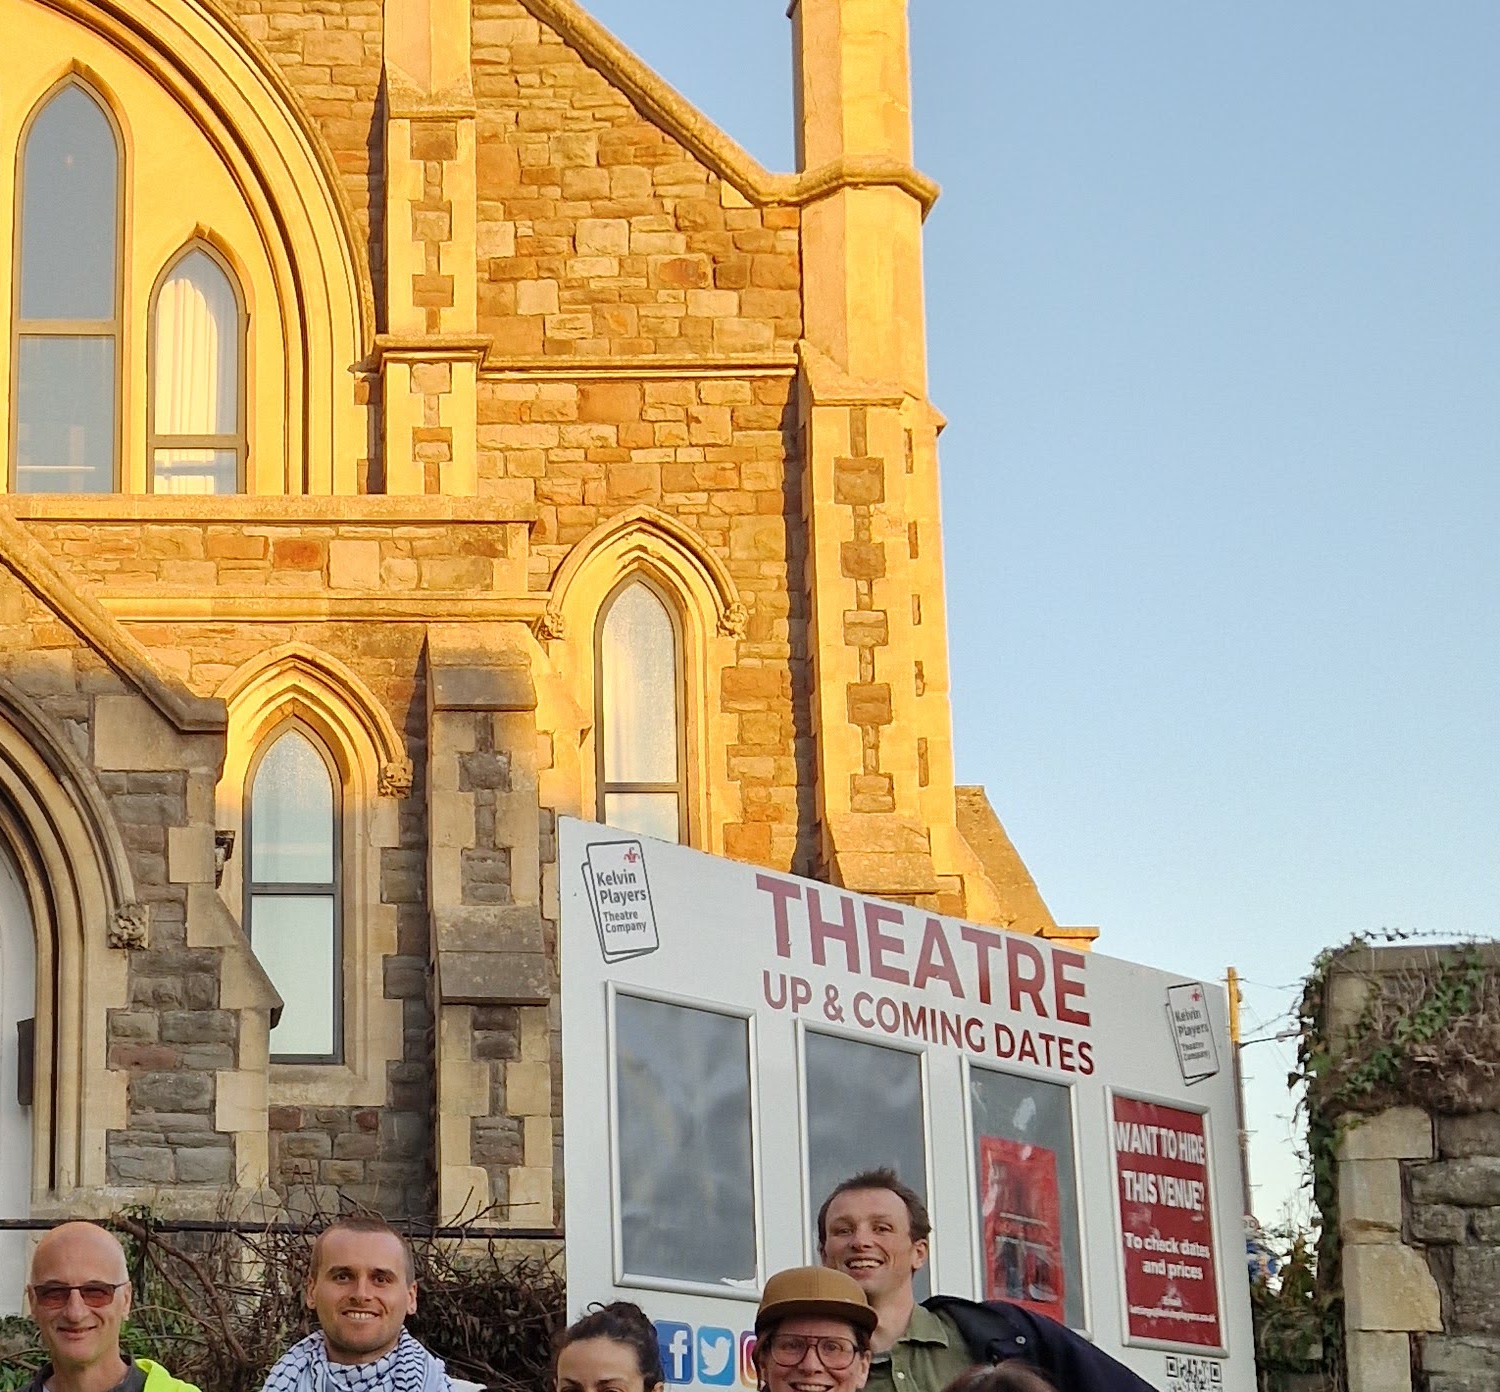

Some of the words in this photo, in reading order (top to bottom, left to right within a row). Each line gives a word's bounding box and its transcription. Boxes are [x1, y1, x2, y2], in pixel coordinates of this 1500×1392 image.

[596, 868, 637, 887] Kelvin
[600, 888, 647, 907] Players
[603, 910, 638, 922] Theatre
[605, 921, 647, 934] Company
[755, 872, 1092, 1027] THEATRE
[762, 969, 813, 1014] UP
[822, 983, 846, 1024] &
[853, 991, 986, 1053] COMING
[994, 1021, 1096, 1076] DATES
[1178, 1023, 1209, 1038] Players
[1114, 1121, 1159, 1156] WANT
[1159, 1127, 1177, 1160] TO
[1177, 1131, 1205, 1166] HIRE
[1122, 1170, 1157, 1205] THIS
[1124, 1232, 1142, 1249] To
[1144, 1235, 1180, 1254] check
[1180, 1239, 1210, 1260] dates
[1142, 1259, 1166, 1276] and
[1167, 1261, 1204, 1281] prices
